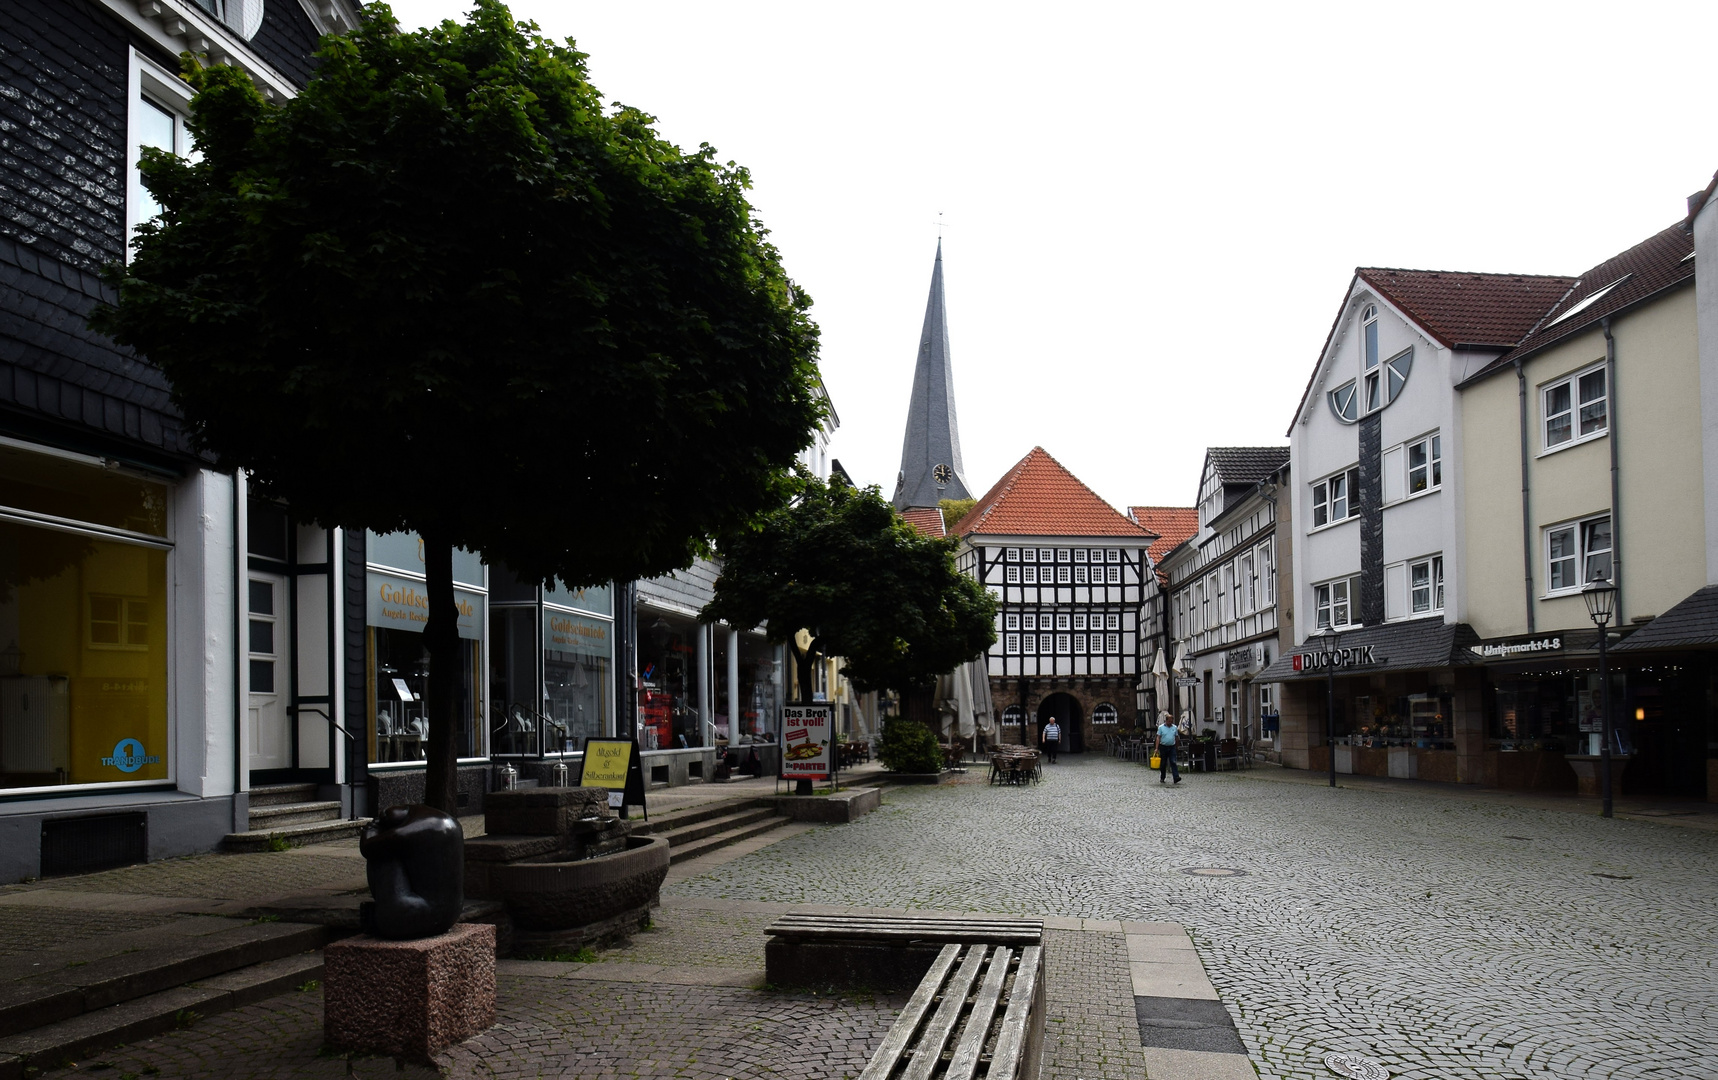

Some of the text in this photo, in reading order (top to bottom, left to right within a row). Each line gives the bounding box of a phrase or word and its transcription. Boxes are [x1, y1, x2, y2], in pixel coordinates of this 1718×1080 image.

[550, 616, 605, 640] Goldschmiede
[1484, 638, 1561, 656] Untermarkt 4-8
[1333, 645, 1375, 667] OPTIK
[784, 708, 827, 718] Das Brot
[787, 717, 824, 726] ist voll!
[793, 762, 826, 770] PARTEI
